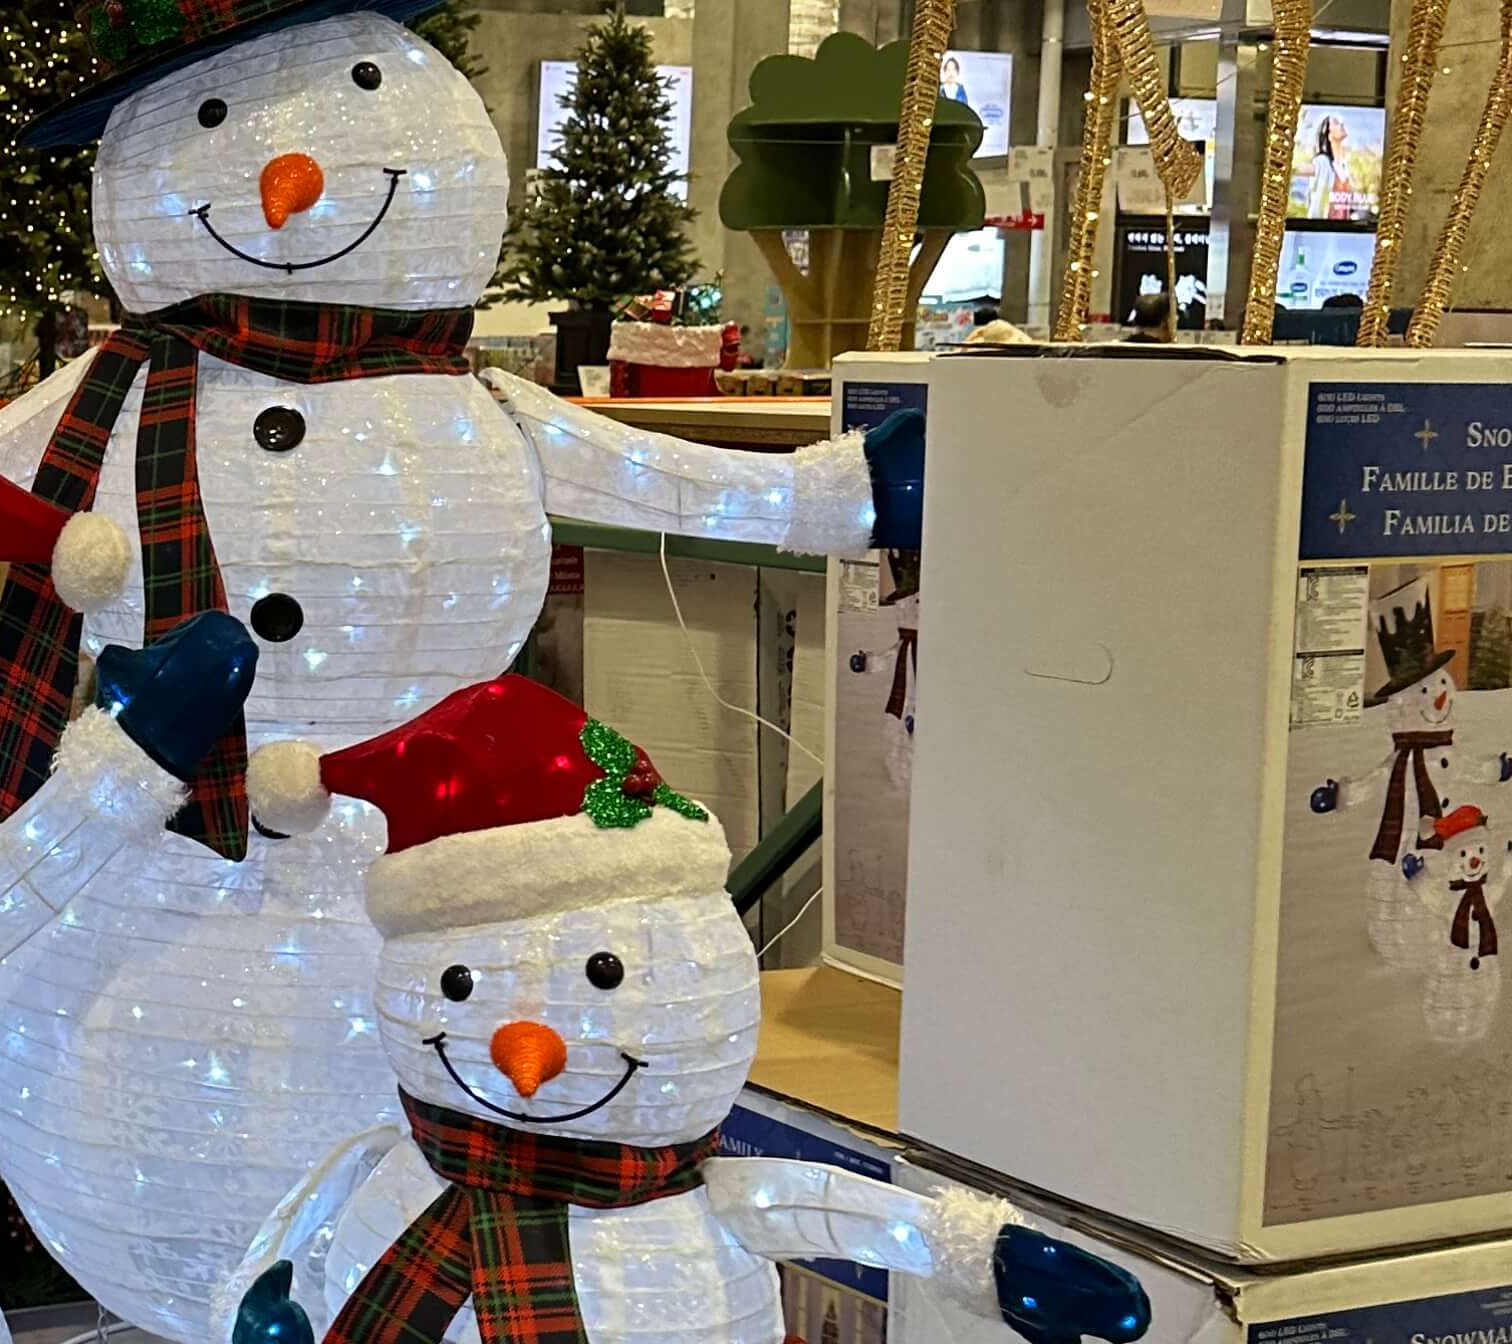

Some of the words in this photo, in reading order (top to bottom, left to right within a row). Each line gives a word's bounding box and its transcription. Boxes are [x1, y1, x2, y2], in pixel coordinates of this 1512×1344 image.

[1361, 466, 1458, 493] FAMILLE
[1465, 472, 1494, 490] DE
[1383, 509, 1475, 536] FAMILIA
[1483, 515, 1510, 533] DE
[716, 1131, 764, 1157] AMILY
